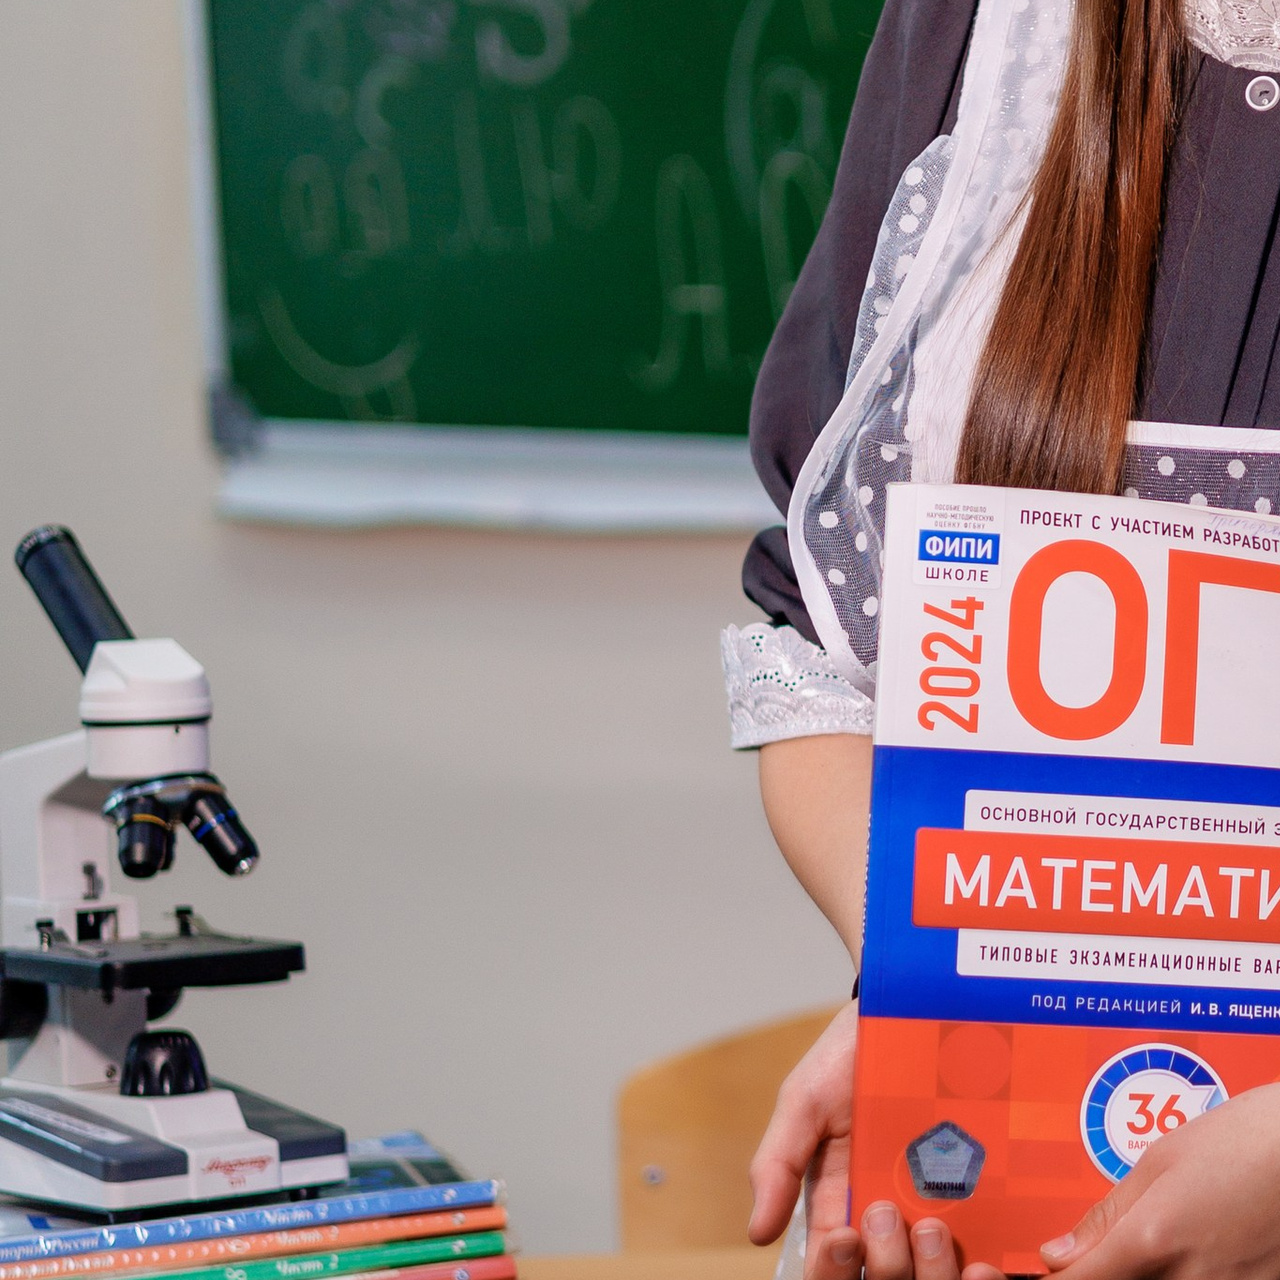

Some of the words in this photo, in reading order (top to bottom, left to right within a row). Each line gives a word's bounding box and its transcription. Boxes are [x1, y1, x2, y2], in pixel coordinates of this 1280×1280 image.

[1020, 509, 1083, 529] ПРОЕКТ
[1091, 515, 1101, 530] С
[1110, 516, 1194, 540] УЧАСТИЕМ
[925, 535, 993, 560] ФИПИ
[925, 567, 989, 582] ШКОЛЕ
[917, 595, 985, 734] 2024
[980, 805, 1076, 825] ОСНОВНОЙ
[1085, 811, 1266, 835] ГОСУДАРСТВЕННЫЙ
[979, 944, 1058, 964] ТИПОВЫЕ
[1068, 949, 1242, 973] ЭКЗАМЕНАЦИОННЫЕ
[1031, 994, 1067, 1011] ПОД
[1075, 996, 1182, 1014] РЕДАКЦИЕЙ
[1126, 1093, 1187, 1136] 36
